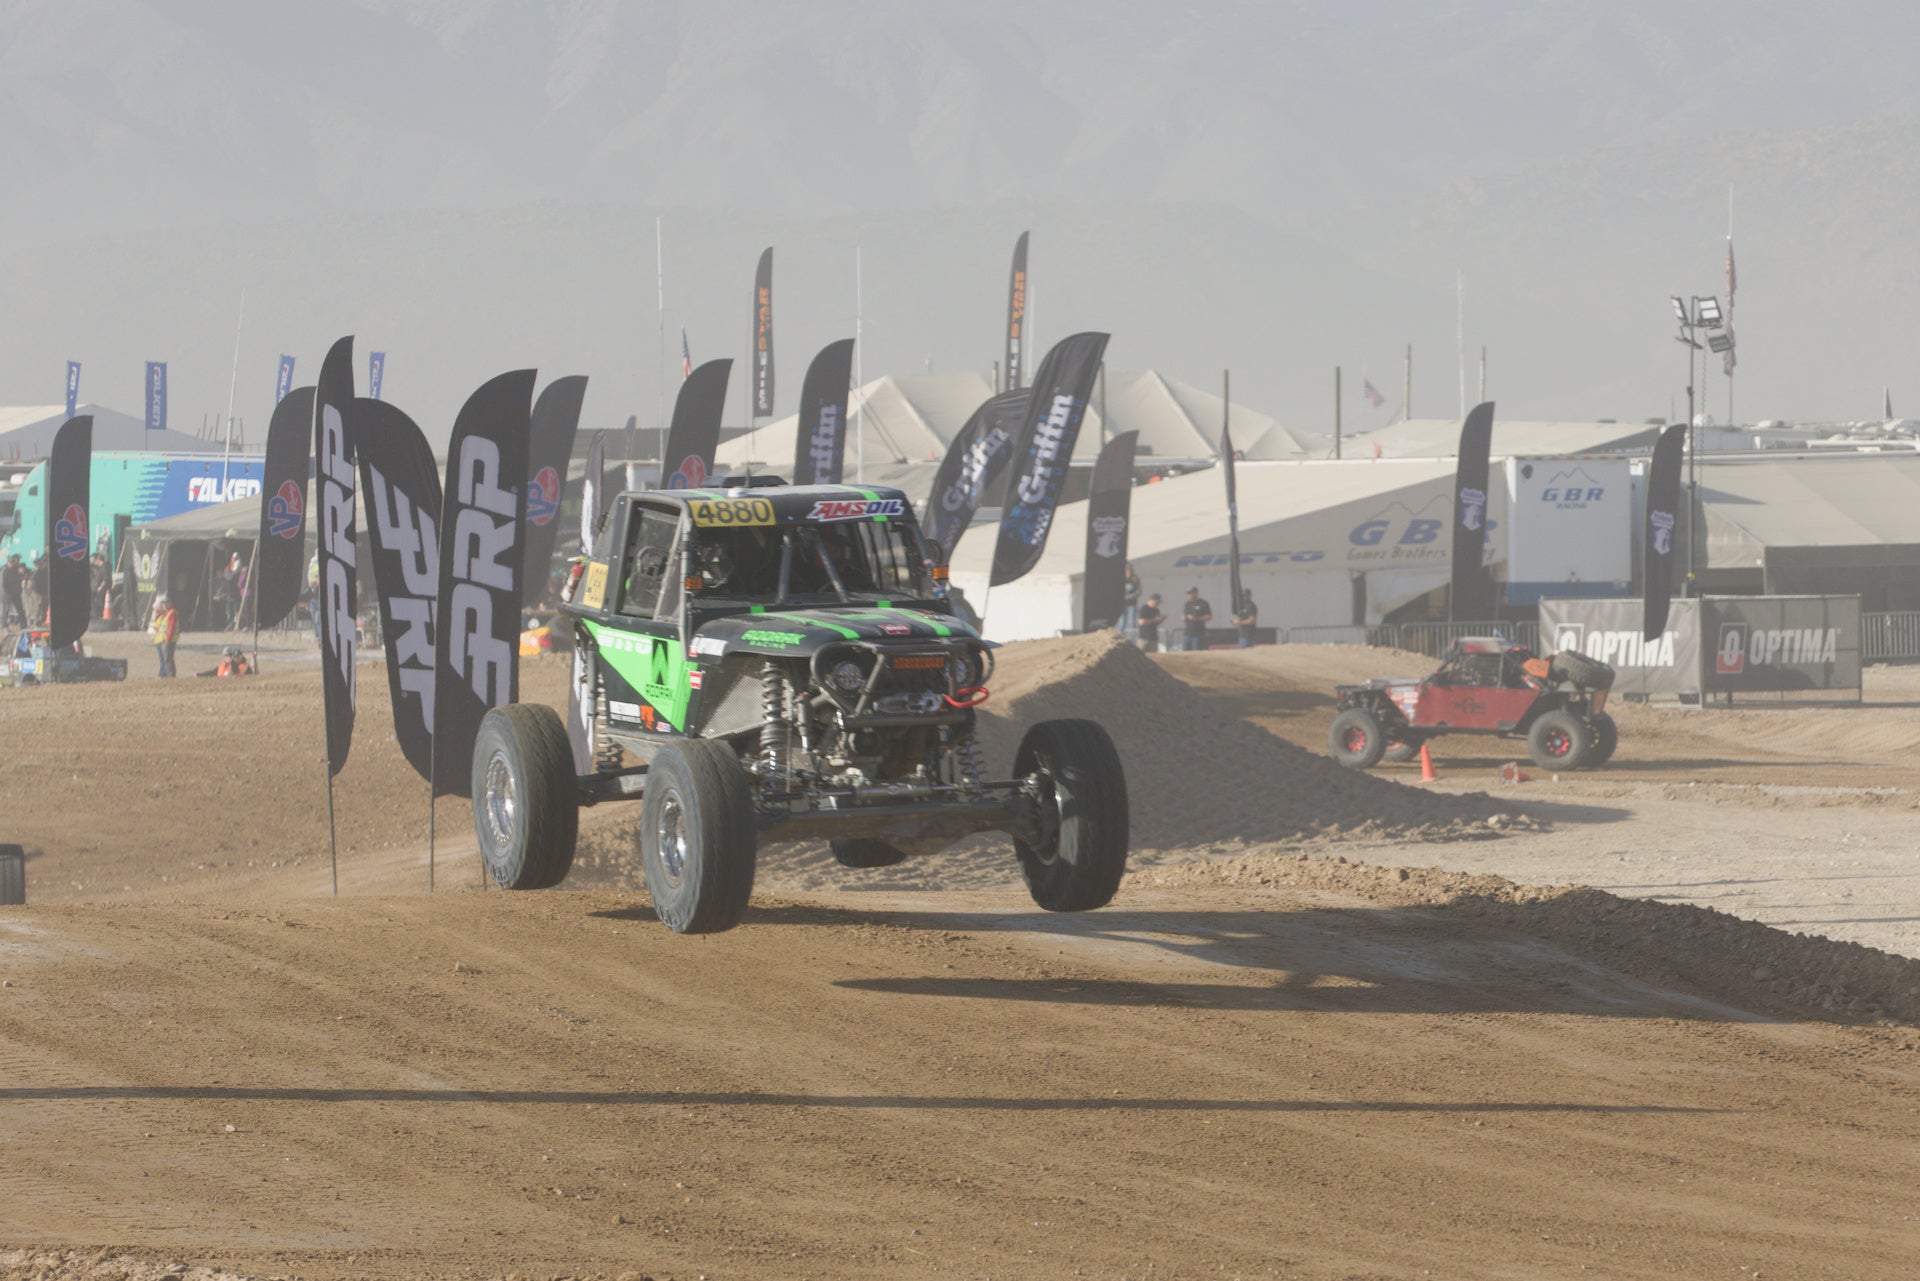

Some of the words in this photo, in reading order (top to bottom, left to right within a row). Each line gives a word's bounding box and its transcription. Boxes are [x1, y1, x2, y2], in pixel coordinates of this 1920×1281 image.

[152, 366, 162, 427] FALKEN
[808, 404, 837, 484] riffin
[1018, 394, 1074, 504] Griffin
[188, 477, 261, 502] FALKEN
[813, 500, 904, 520] AMSOIL
[1541, 487, 1604, 502] GBR
[269, 496, 303, 537] VP
[697, 500, 771, 525] 4880
[55, 519, 87, 560] VP
[321, 403, 356, 713] PRP
[449, 434, 518, 706] PRP
[1586, 631, 1675, 667] OPTIMA
[1749, 628, 1836, 665] OPTIMA
